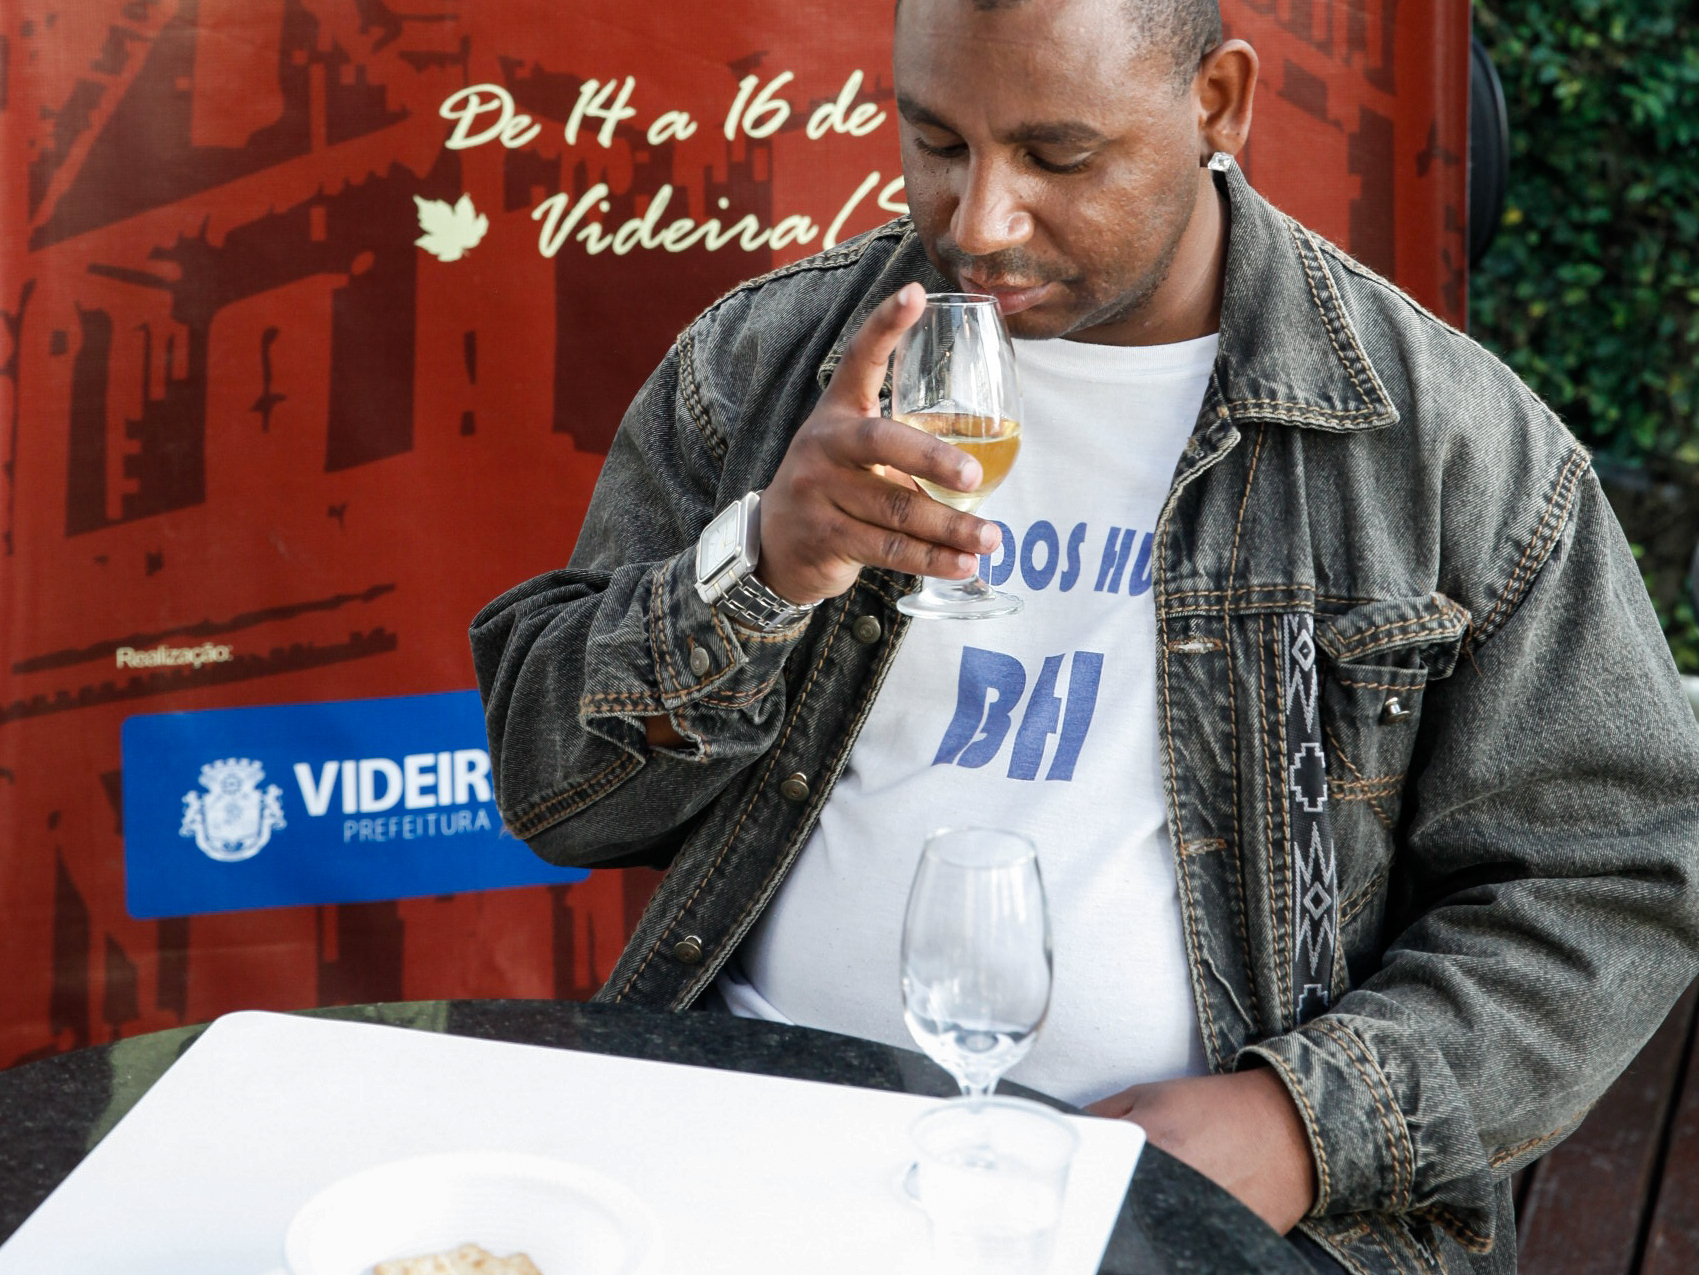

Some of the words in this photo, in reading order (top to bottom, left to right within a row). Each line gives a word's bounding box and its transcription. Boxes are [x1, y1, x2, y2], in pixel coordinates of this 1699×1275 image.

[439, 82, 542, 151] De
[563, 75, 637, 149] 14
[646, 108, 698, 146] a
[722, 69, 794, 141] 16
[806, 68, 887, 141] de
[930, 645, 1105, 782] BH
[293, 748, 495, 817] VIDEIR
[343, 808, 492, 843] PREFEITURA
